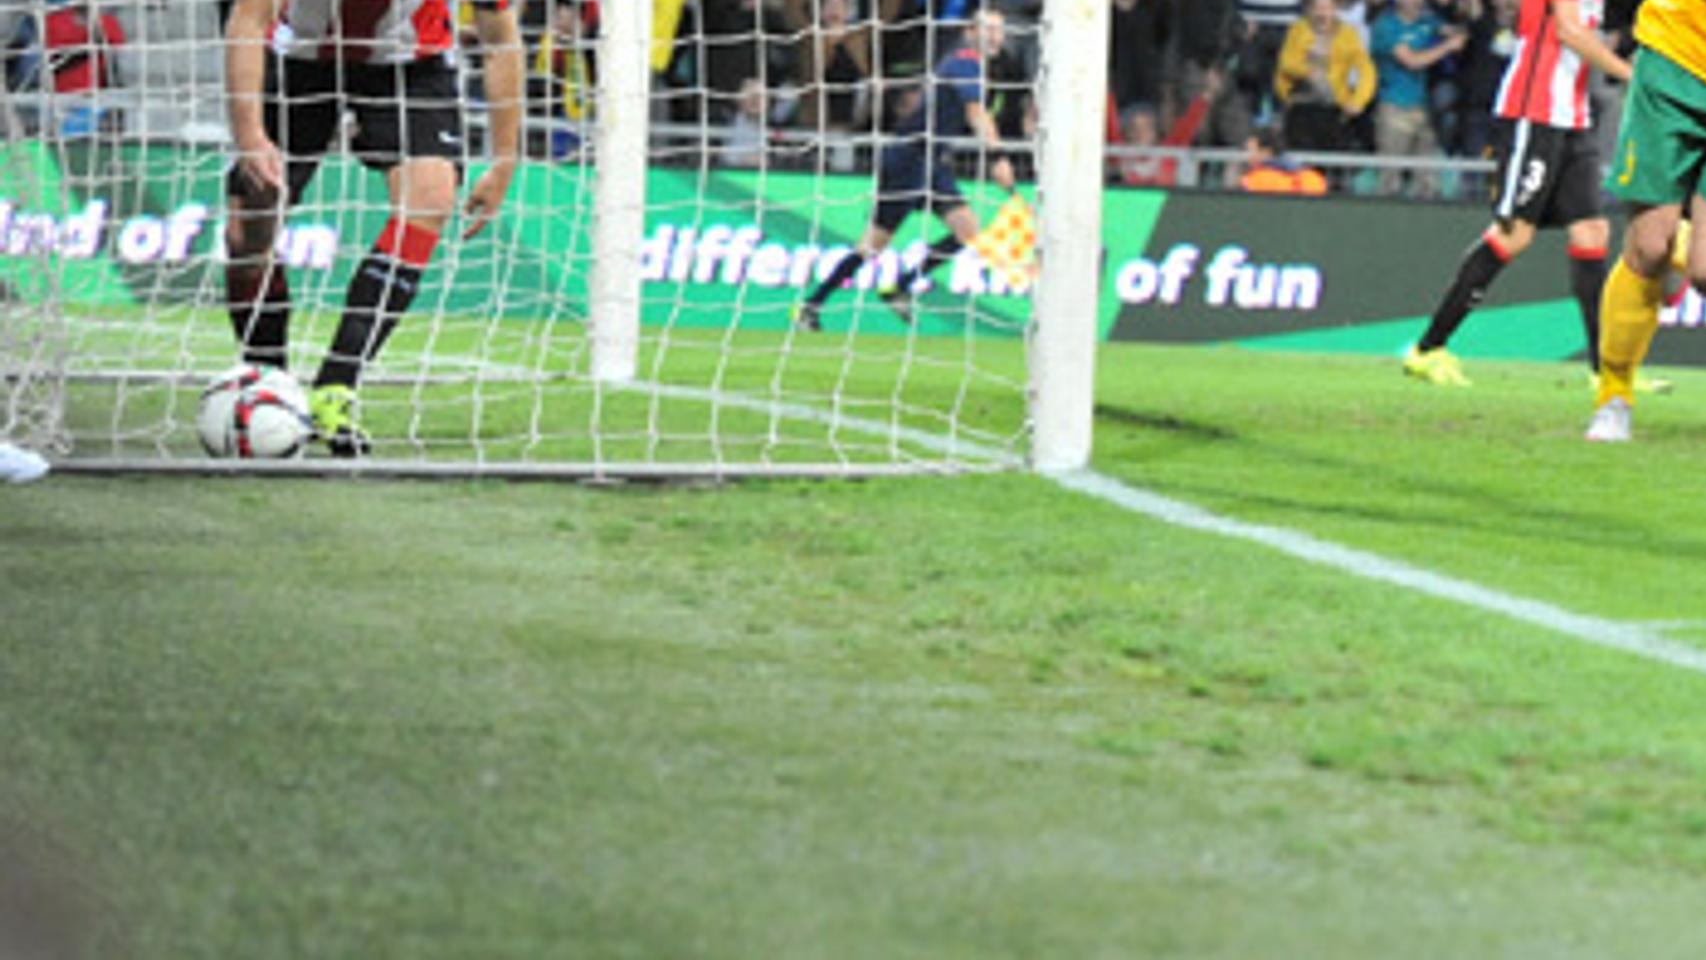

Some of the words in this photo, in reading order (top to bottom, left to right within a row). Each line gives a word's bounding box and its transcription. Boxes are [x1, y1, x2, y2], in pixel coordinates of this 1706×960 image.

[117, 201, 209, 264] of
[1115, 242, 1200, 304] of
[1204, 243, 1322, 309] fun
